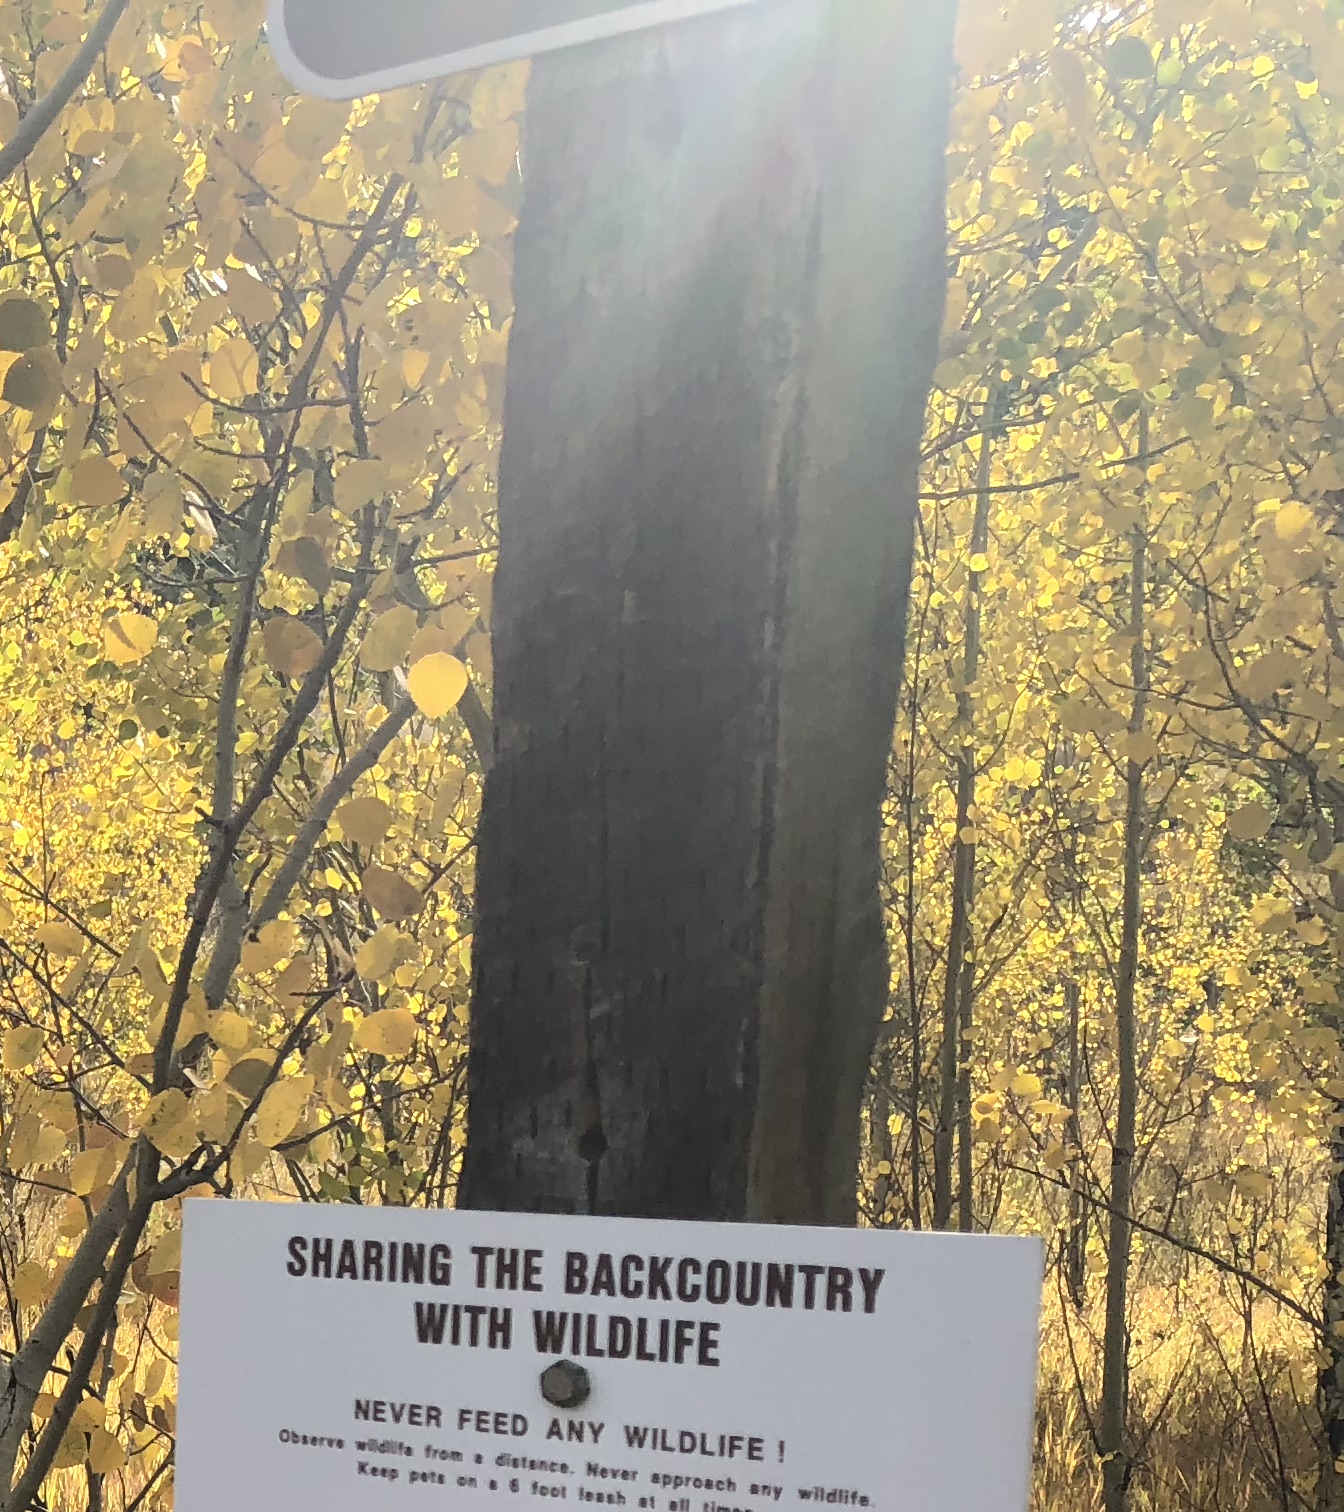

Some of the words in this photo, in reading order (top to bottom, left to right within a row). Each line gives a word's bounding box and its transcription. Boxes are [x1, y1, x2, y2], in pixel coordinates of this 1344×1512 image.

[286, 1236, 452, 1286] SHARING
[469, 1245, 544, 1292] THE
[564, 1250, 886, 1314] BACKCOUNTRY
[413, 1301, 512, 1350] WITH
[532, 1310, 721, 1367] WILDLIFE
[354, 1399, 442, 1428] NEVER
[457, 1408, 529, 1437] FEED
[546, 1418, 605, 1444] ANY
[623, 1425, 765, 1462] WILDLIFE
[279, 1429, 345, 1449] Observe
[354, 1438, 414, 1457] wildlife
[424, 1444, 463, 1462] from
[494, 1452, 575, 1475] distance.
[585, 1461, 638, 1481] Never
[650, 1473, 737, 1492] approach
[748, 1483, 783, 1501] any
[798, 1486, 875, 1507] wildlife.
[357, 1461, 399, 1482] Keep
[409, 1470, 445, 1485] pets
[456, 1476, 477, 1488] on
[531, 1480, 567, 1499] foot
[577, 1486, 626, 1505] leash
